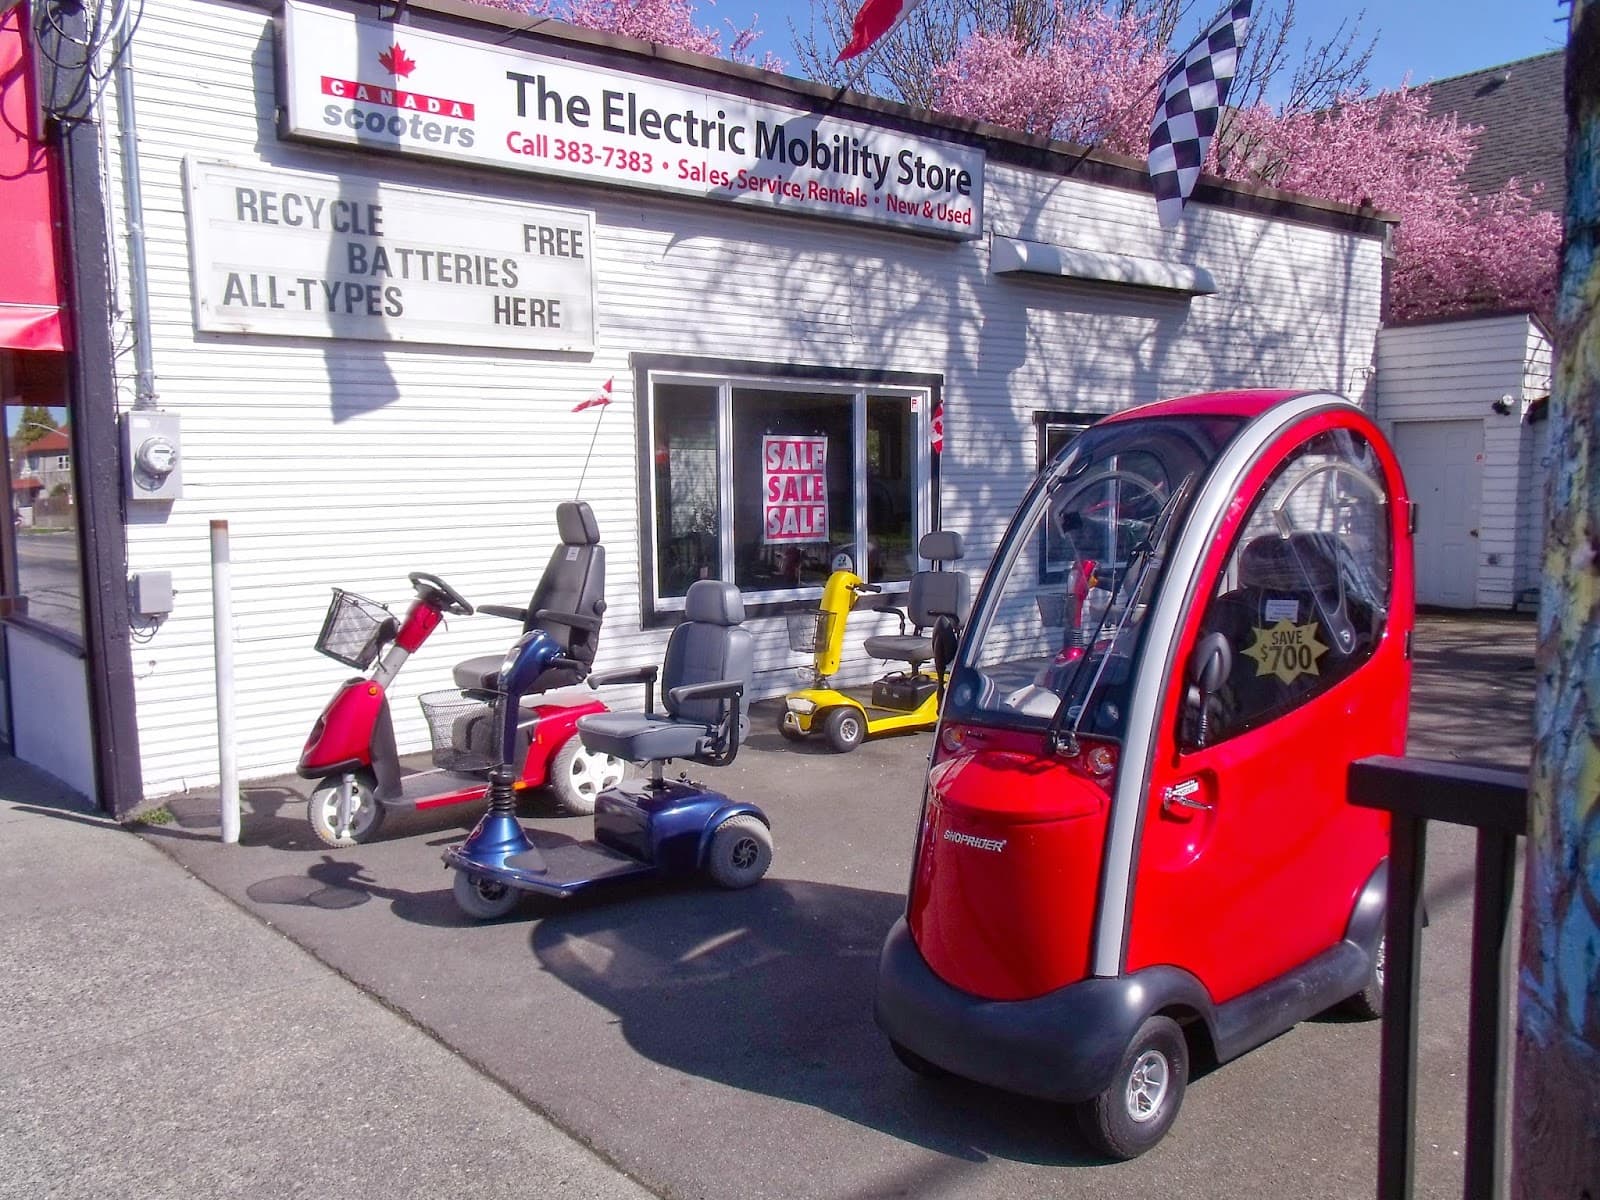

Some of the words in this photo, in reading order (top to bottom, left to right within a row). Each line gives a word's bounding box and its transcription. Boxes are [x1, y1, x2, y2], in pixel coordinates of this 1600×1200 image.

[330, 81, 463, 117] CANADA
[323, 104, 475, 148] scooters
[506, 71, 590, 128] The
[602, 90, 745, 155] Electric
[755, 121, 890, 190] Mobility
[898, 150, 972, 196] Store
[506, 131, 548, 158] Call
[554, 139, 653, 174] 383-7383
[678, 159, 734, 191] Sales,
[737, 169, 805, 201] Service,
[808, 180, 867, 208] Rentals
[886, 193, 919, 216] New
[922, 201, 933, 219] &
[937, 203, 972, 225] Used
[235, 187, 384, 237] RECYCLE
[523, 224, 584, 259] FREE
[347, 242, 518, 289] BATTERIES
[223, 272, 404, 317] ALL-TYPES
[494, 295, 561, 329] HERE
[767, 443, 824, 470] SALE
[768, 476, 825, 502] SALE
[767, 507, 825, 535] SALE
[1271, 631, 1303, 645] SAVE
[1260, 644, 1312, 671] $700
[943, 829, 1004, 853] SHOPRIDER
